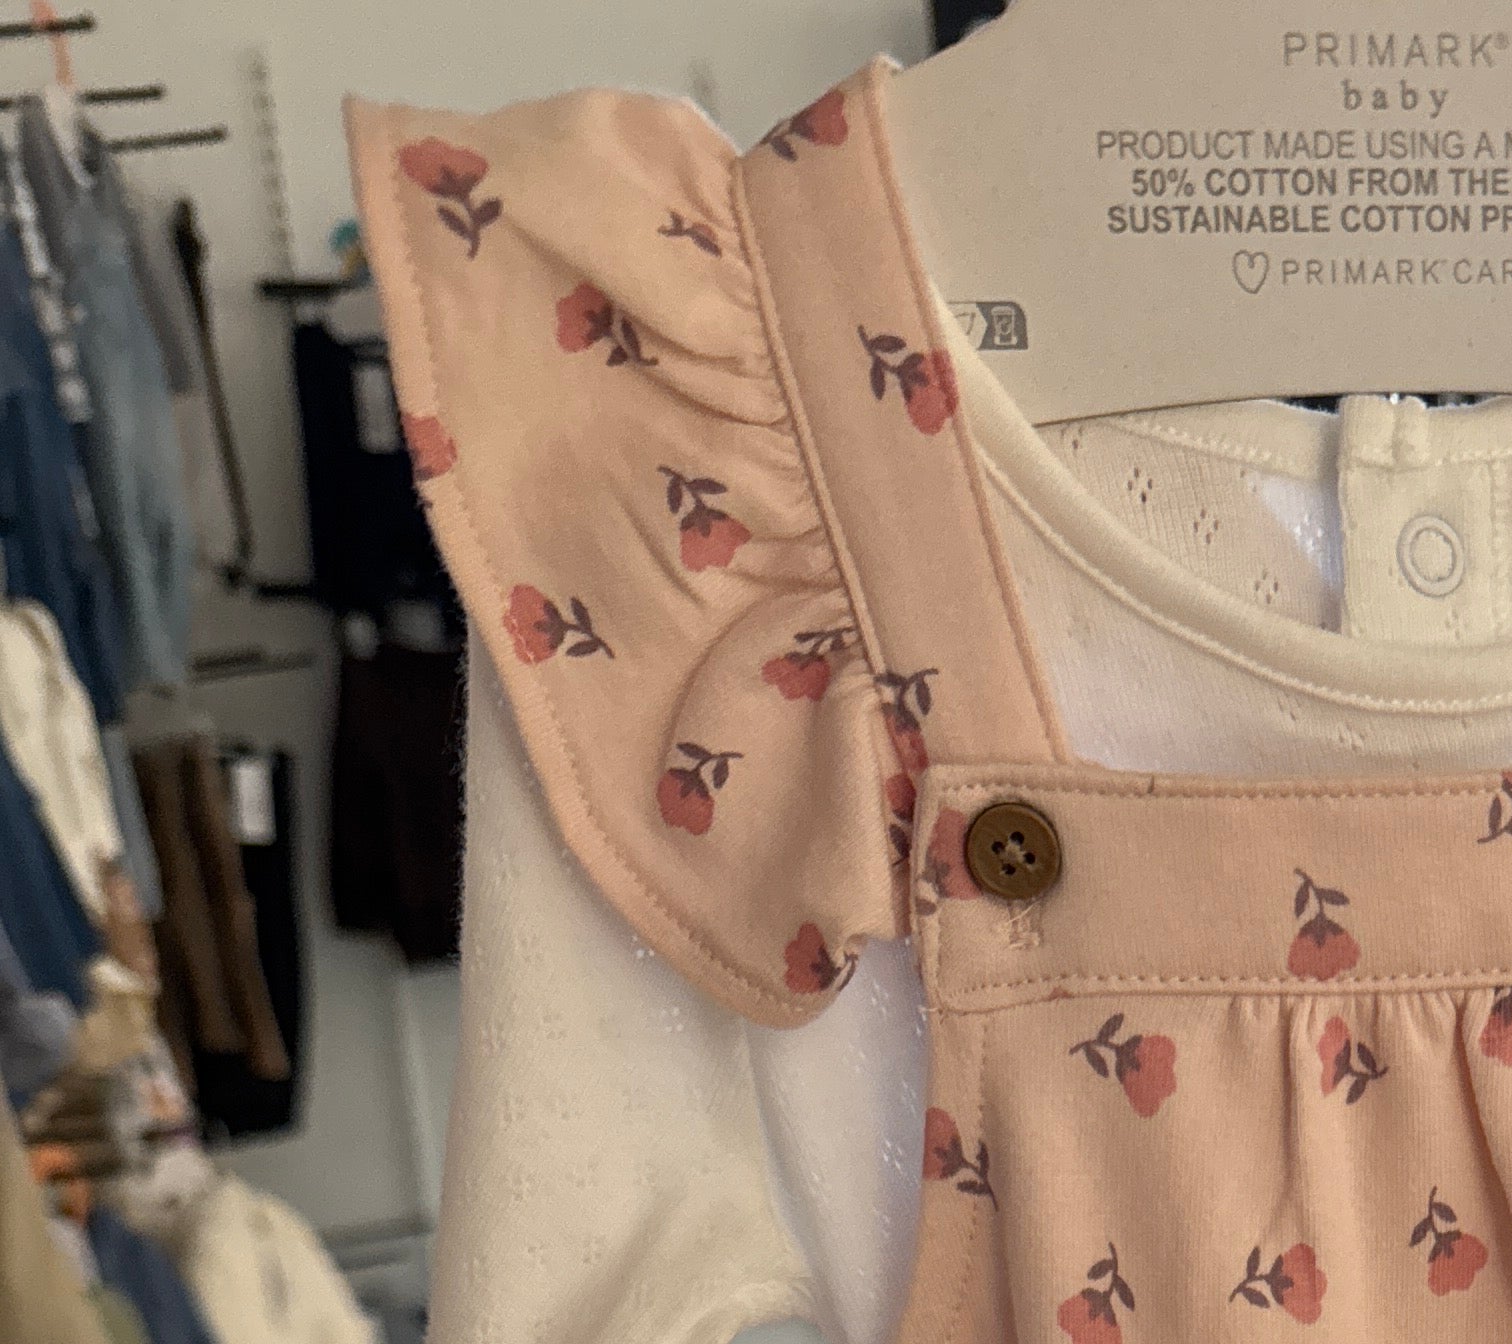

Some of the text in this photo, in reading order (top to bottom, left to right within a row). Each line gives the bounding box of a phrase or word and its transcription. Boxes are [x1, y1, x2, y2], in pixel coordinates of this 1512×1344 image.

[1340, 78, 1448, 120] baby
[1097, 130, 1253, 161] PRODUCT
[1263, 130, 1356, 160] MADE
[1365, 130, 1466, 160] USING
[1473, 130, 1496, 160] A
[1131, 167, 1196, 198] 50%
[1203, 167, 1338, 197] COTTON
[1348, 167, 1439, 197] FROM
[1448, 167, 1510, 196] THE
[1107, 203, 1331, 234] SUSTAINABLE
[1340, 203, 1471, 233] COTTON
